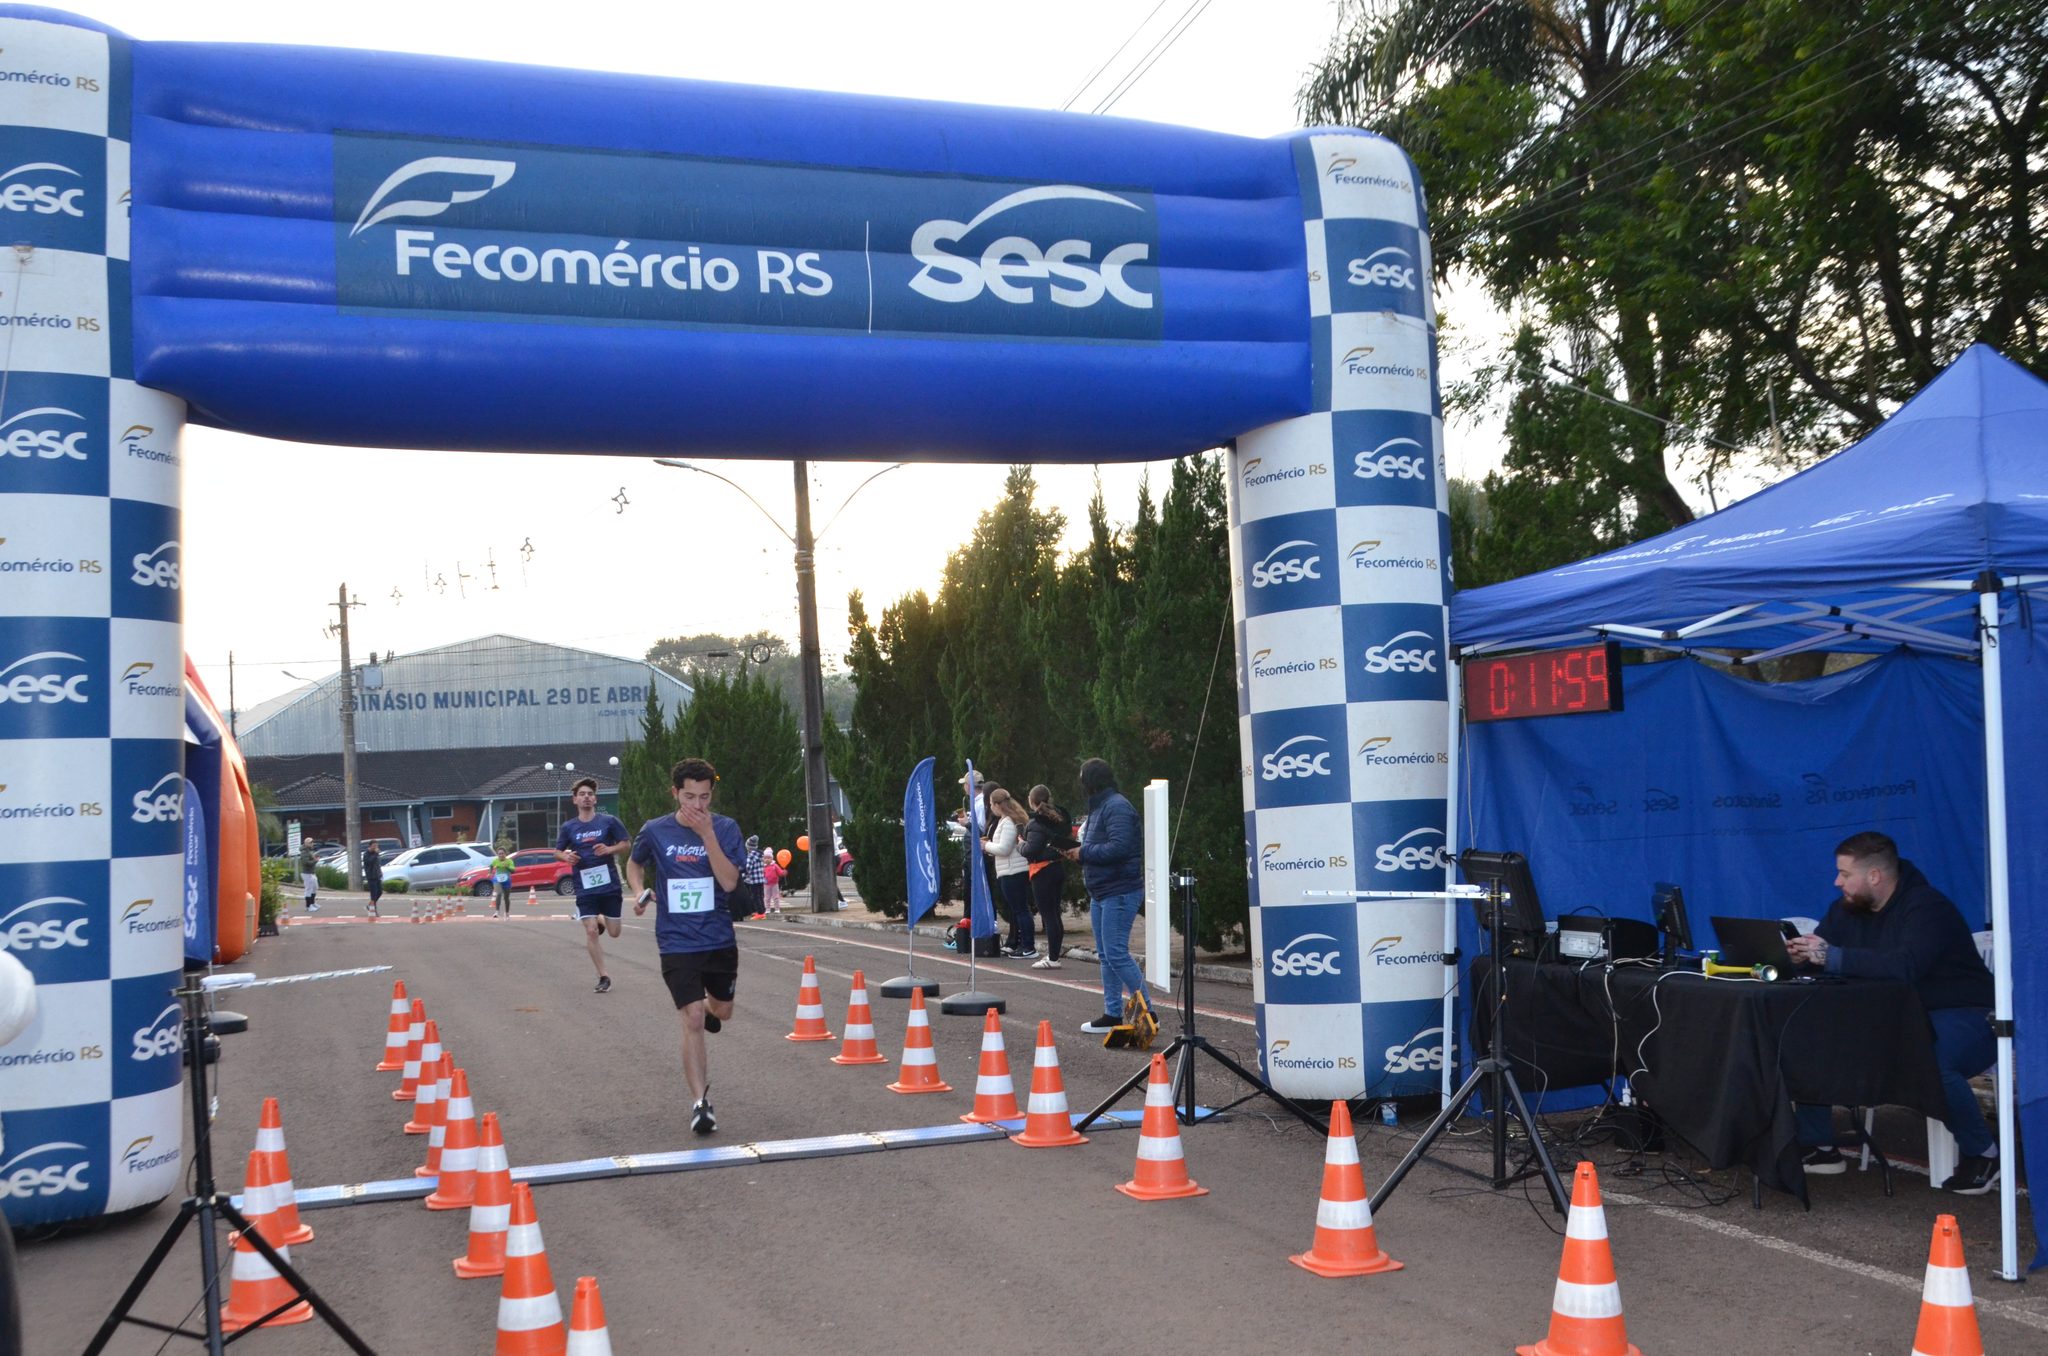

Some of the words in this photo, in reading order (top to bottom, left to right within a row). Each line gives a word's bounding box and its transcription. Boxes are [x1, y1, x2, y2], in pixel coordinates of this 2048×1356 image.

[0, 70, 70, 87] omércio
[76, 76, 100, 92] RS
[0, 183, 84, 217] esc
[395, 229, 740, 292] Fecomércio
[757, 250, 833, 296] RS
[908, 219, 1154, 308] Sesc
[1348, 258, 1416, 291] Sesc
[0, 313, 72, 328] omércio
[77, 316, 101, 332] RS
[1349, 364, 1414, 378] Fecomércio
[1416, 367, 1428, 380] RS
[0, 428, 88, 460] esc
[1245, 466, 1306, 488] Fecomércio
[1309, 464, 1327, 476] RS
[1354, 452, 1426, 481] Sesc
[0, 557, 74, 573] omércio
[79, 560, 103, 574] RS
[1252, 556, 1321, 589] Sesc
[1355, 557, 1424, 569] Fecomércio
[1426, 558, 1438, 570] RS
[1254, 661, 1316, 678] Fecomércio
[1319, 658, 1338, 670] RS
[1364, 646, 1437, 673] Sesc
[0, 674, 89, 703] esc
[434, 689, 540, 709] MUNICIPAL
[547, 687, 571, 705] 29
[577, 687, 600, 704] DE
[607, 686, 648, 704] ABRI
[1262, 752, 1331, 781] Sesc
[1366, 752, 1435, 765] Fecomércio
[1437, 752, 1449, 764] RS
[80, 802, 103, 816] RS
[1264, 858, 1325, 871] Fecomércio
[1329, 856, 1348, 868] RS
[589, 873, 604, 886] 32
[184, 875, 199, 940] Sesc
[680, 891, 702, 911] 57
[1271, 949, 1341, 977] Sesc
[81, 1045, 103, 1060] RS
[1273, 1056, 1334, 1069] Fecomércio
[1338, 1057, 1357, 1069] RS
